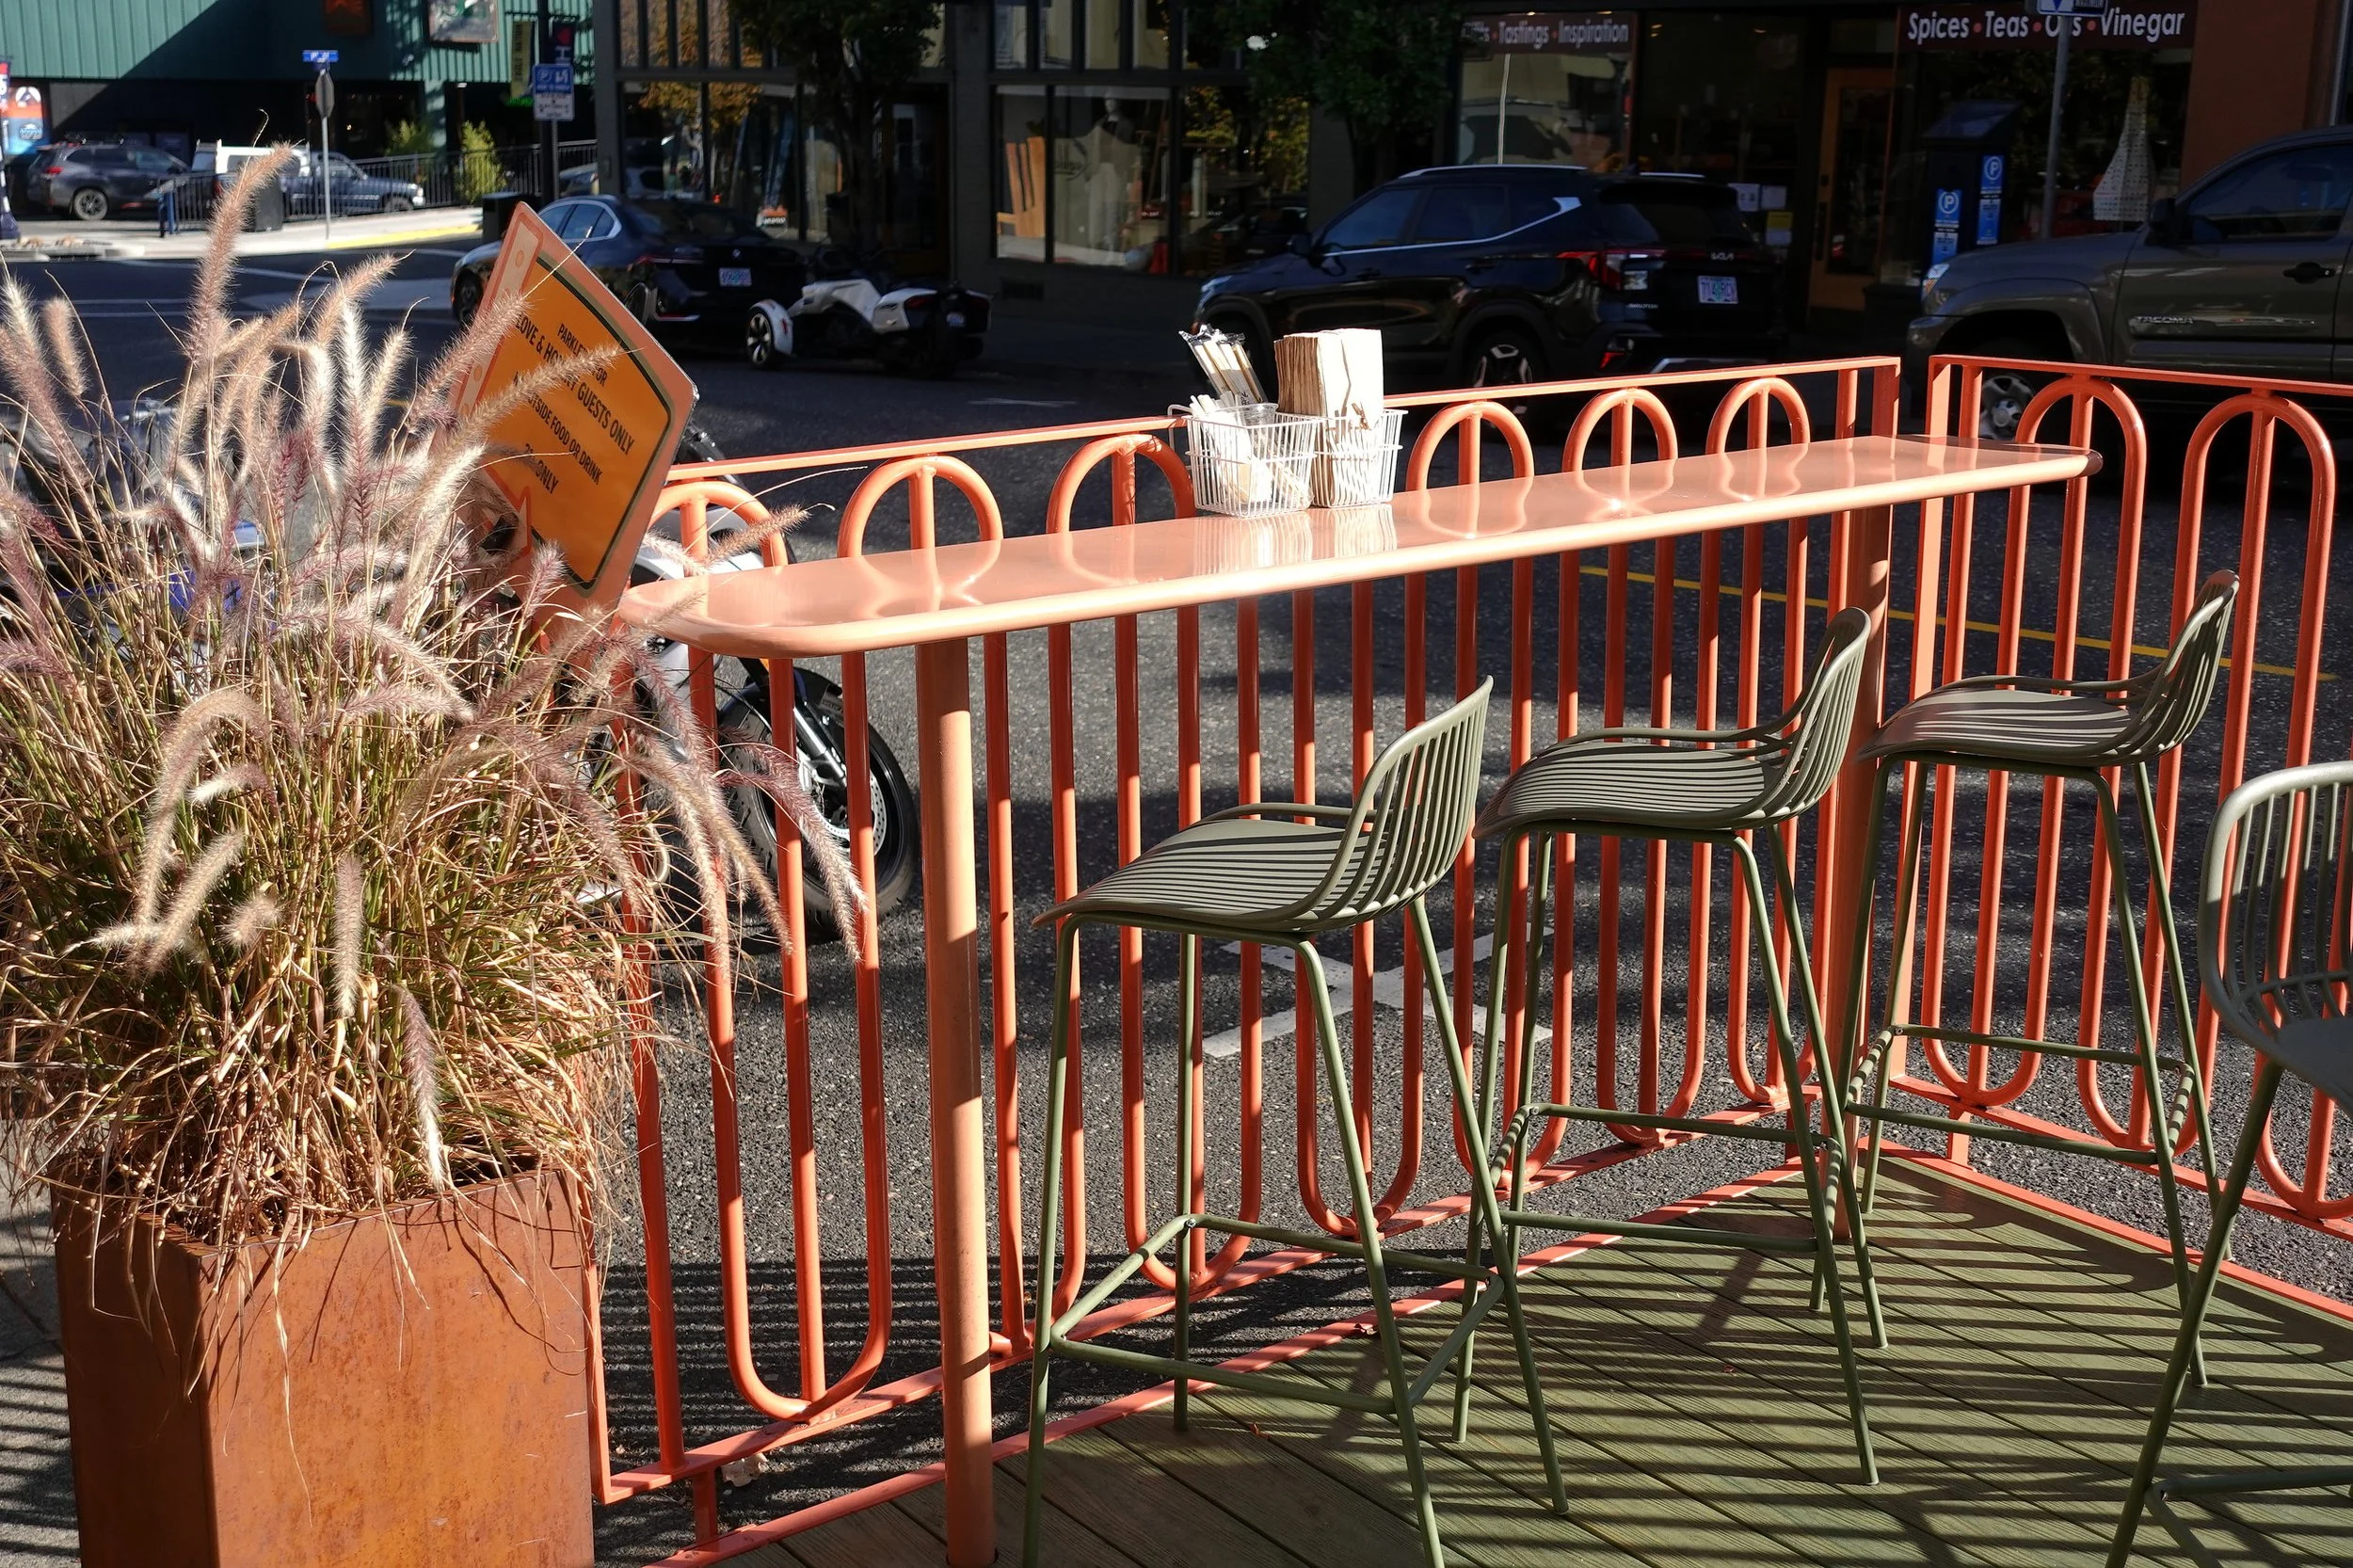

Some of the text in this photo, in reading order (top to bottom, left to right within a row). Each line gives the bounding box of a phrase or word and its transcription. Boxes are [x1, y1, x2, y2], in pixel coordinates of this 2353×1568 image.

[1498, 21, 1549, 49] Tastings
[1559, 19, 1629, 48] Inspiration
[1908, 7, 2185, 45] Spices Teas Os Vinegar
[536, 335, 545, 354] &
[577, 382, 612, 429] GUESTS
[609, 419, 635, 456] ONLY
[551, 416, 570, 446] FOOD
[568, 439, 582, 456] OR
[579, 451, 602, 486] DRINK
[536, 459, 559, 494] ONLY
